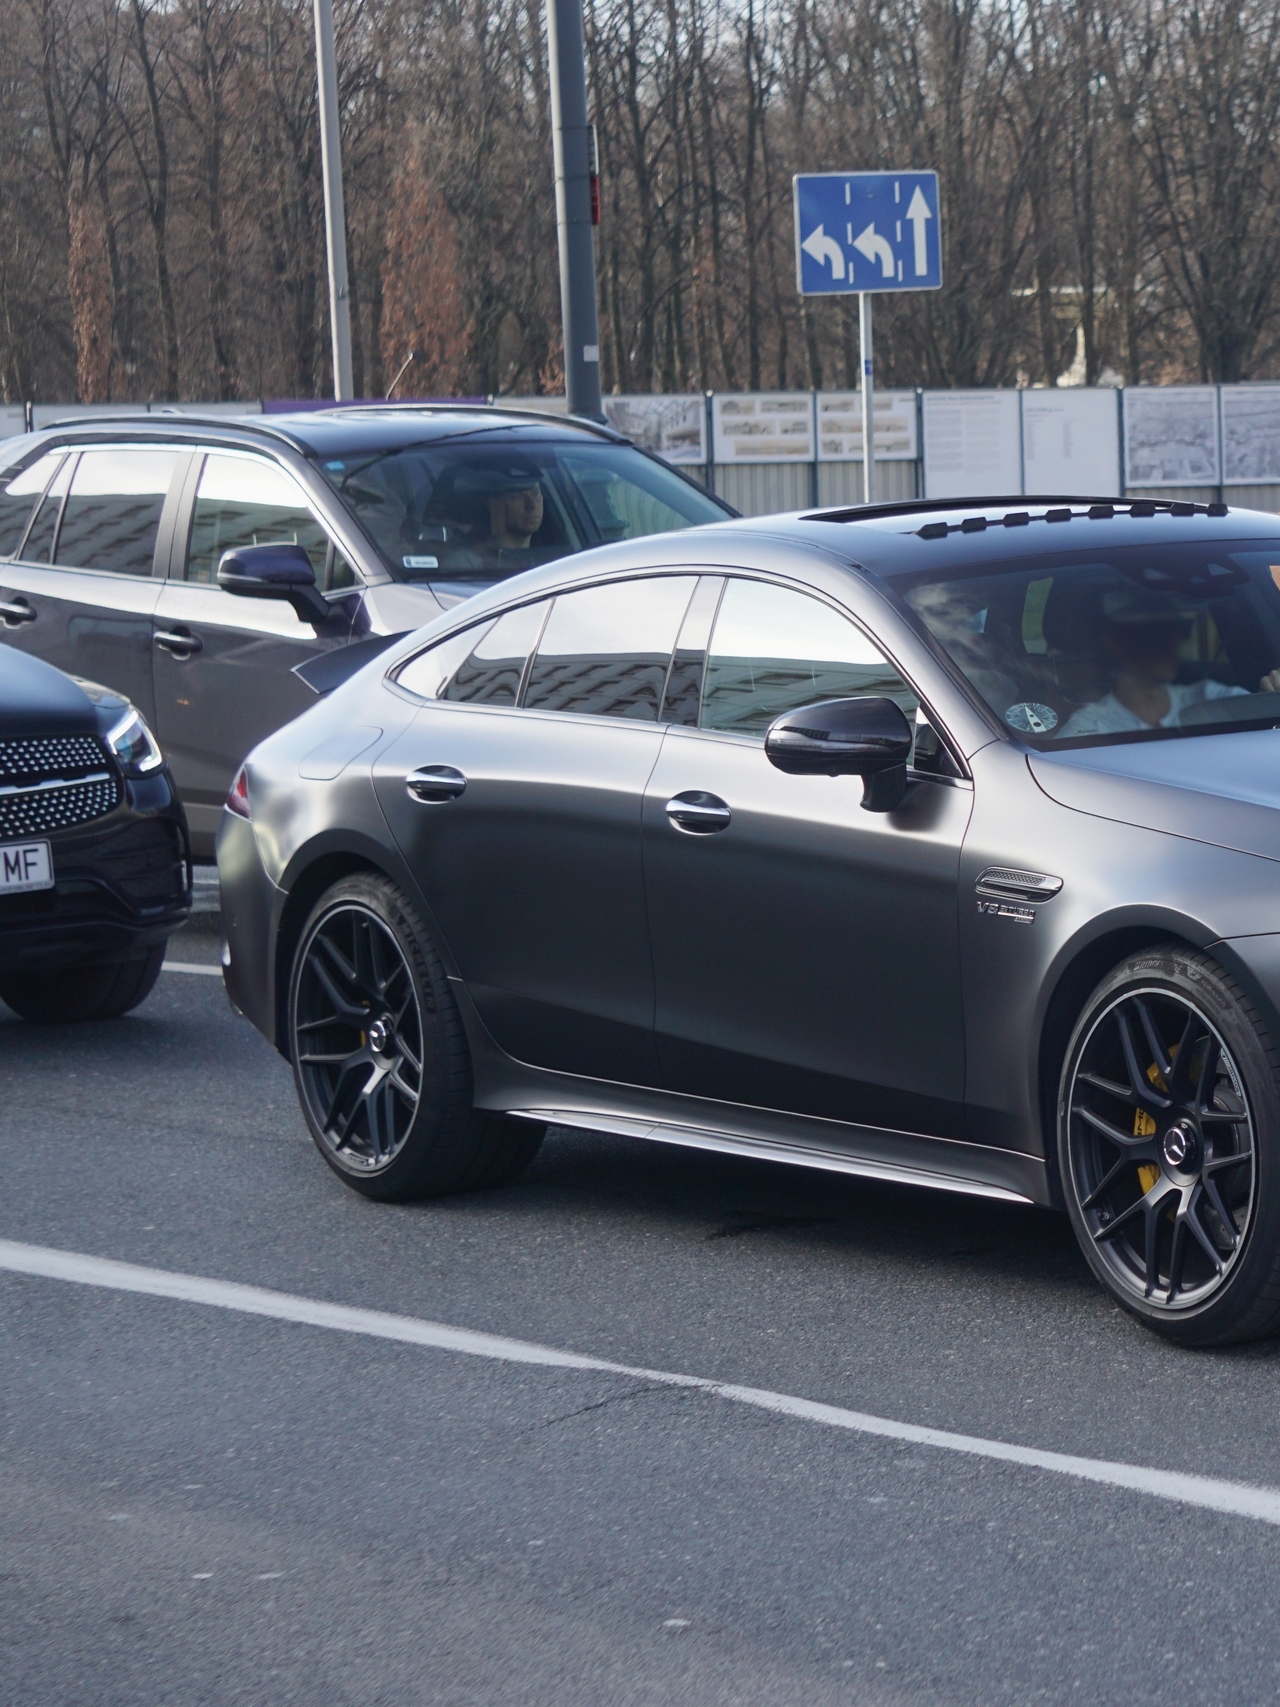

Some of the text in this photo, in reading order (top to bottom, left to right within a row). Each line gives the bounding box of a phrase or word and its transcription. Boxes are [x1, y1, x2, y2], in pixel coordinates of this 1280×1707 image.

[0, 848, 39, 882] MF
[976, 901, 1035, 917] V8 BITURBO
[401, 922, 435, 1008] MICHELIN
[1133, 960, 1183, 974] BRIDGESTONE
[1200, 980, 1226, 1008] TURANZA
